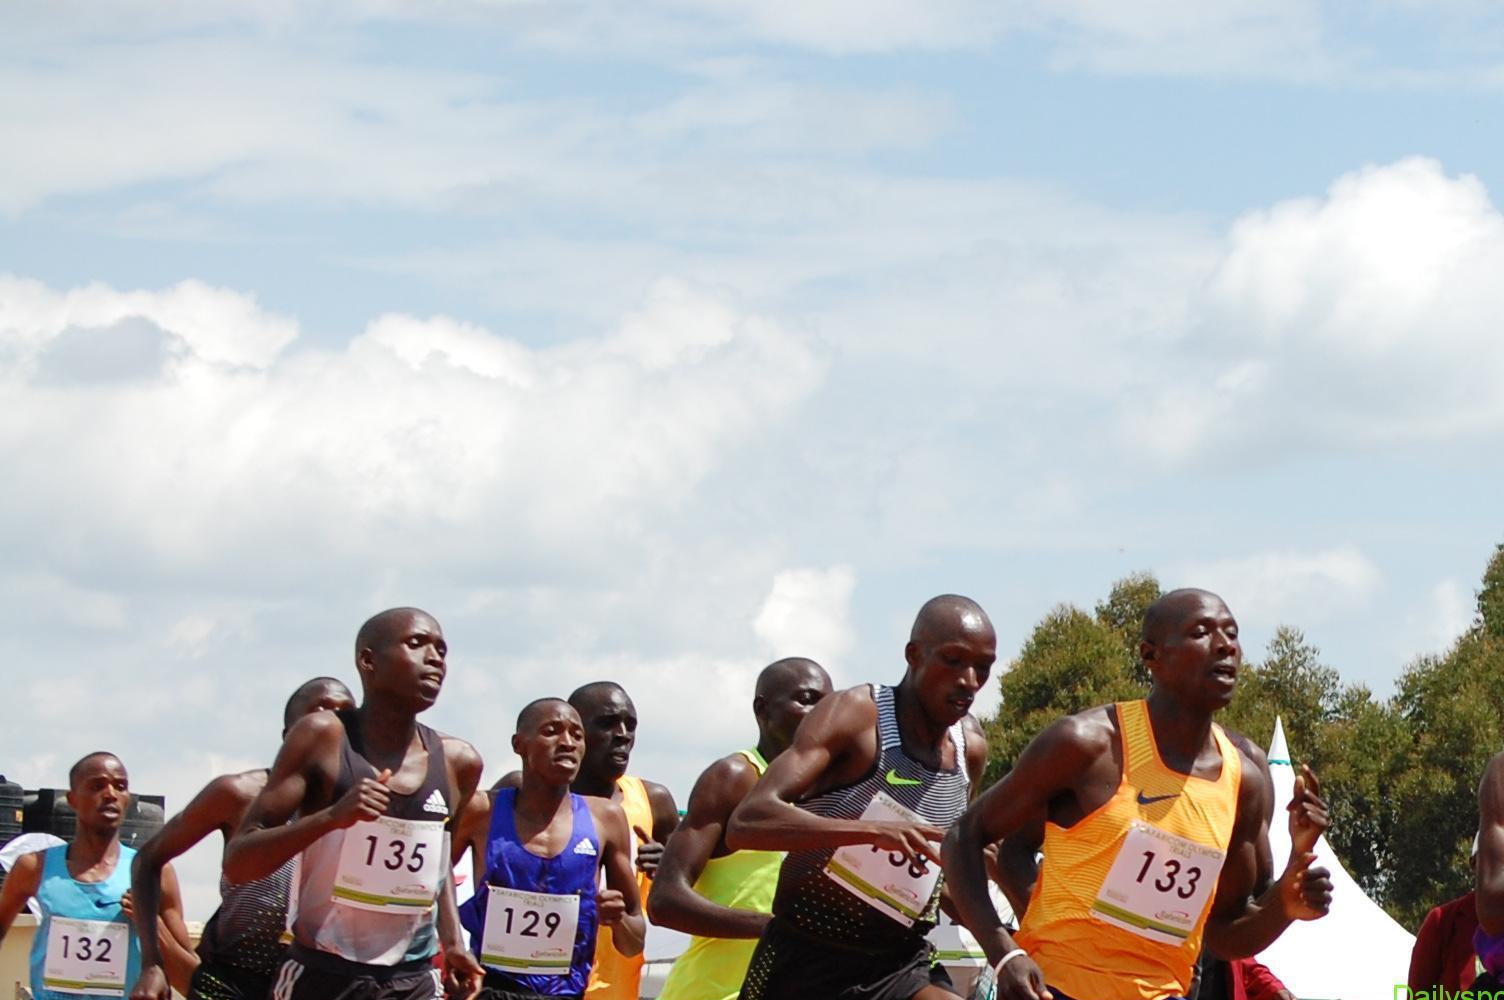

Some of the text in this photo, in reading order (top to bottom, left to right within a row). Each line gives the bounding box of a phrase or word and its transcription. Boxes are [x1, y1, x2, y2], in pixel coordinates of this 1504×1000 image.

[366, 835, 427, 872] 135
[1136, 851, 1202, 899] 133
[504, 907, 561, 938] 129
[62, 935, 112, 962] 132
